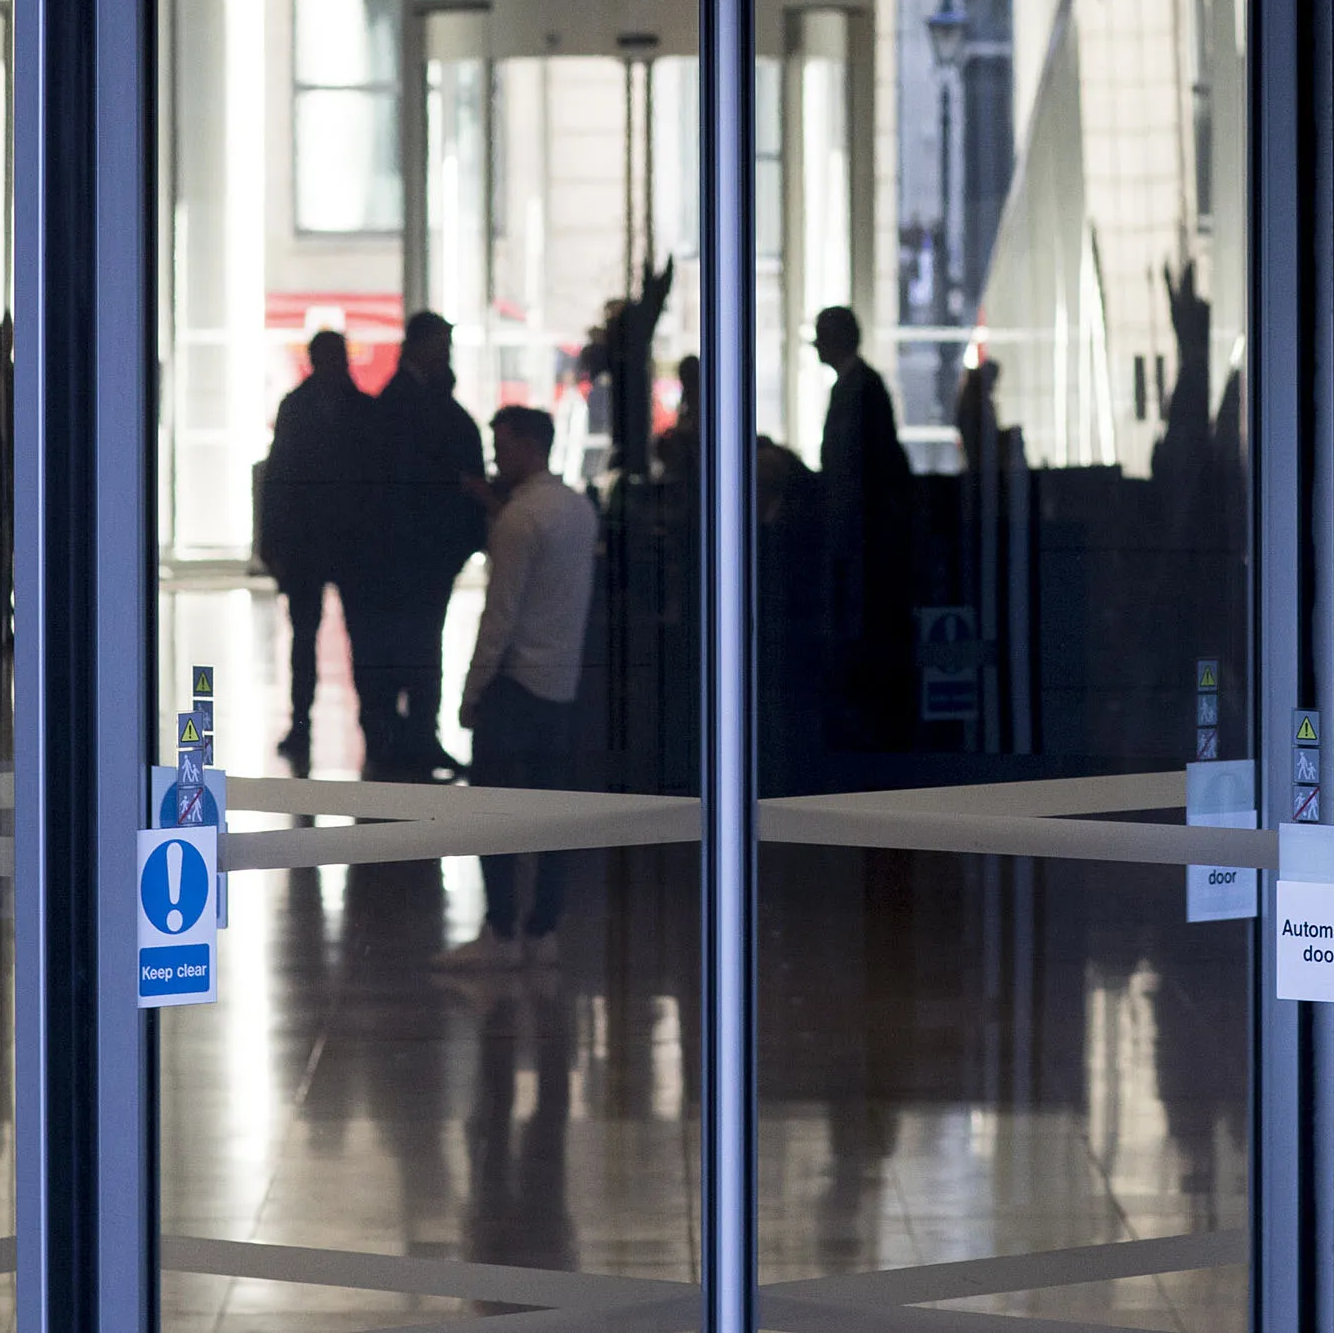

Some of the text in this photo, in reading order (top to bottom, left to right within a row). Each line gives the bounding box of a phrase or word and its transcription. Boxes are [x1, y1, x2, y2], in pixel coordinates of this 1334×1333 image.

[1208, 869, 1237, 885] door
[142, 963, 208, 983] Keep clear
